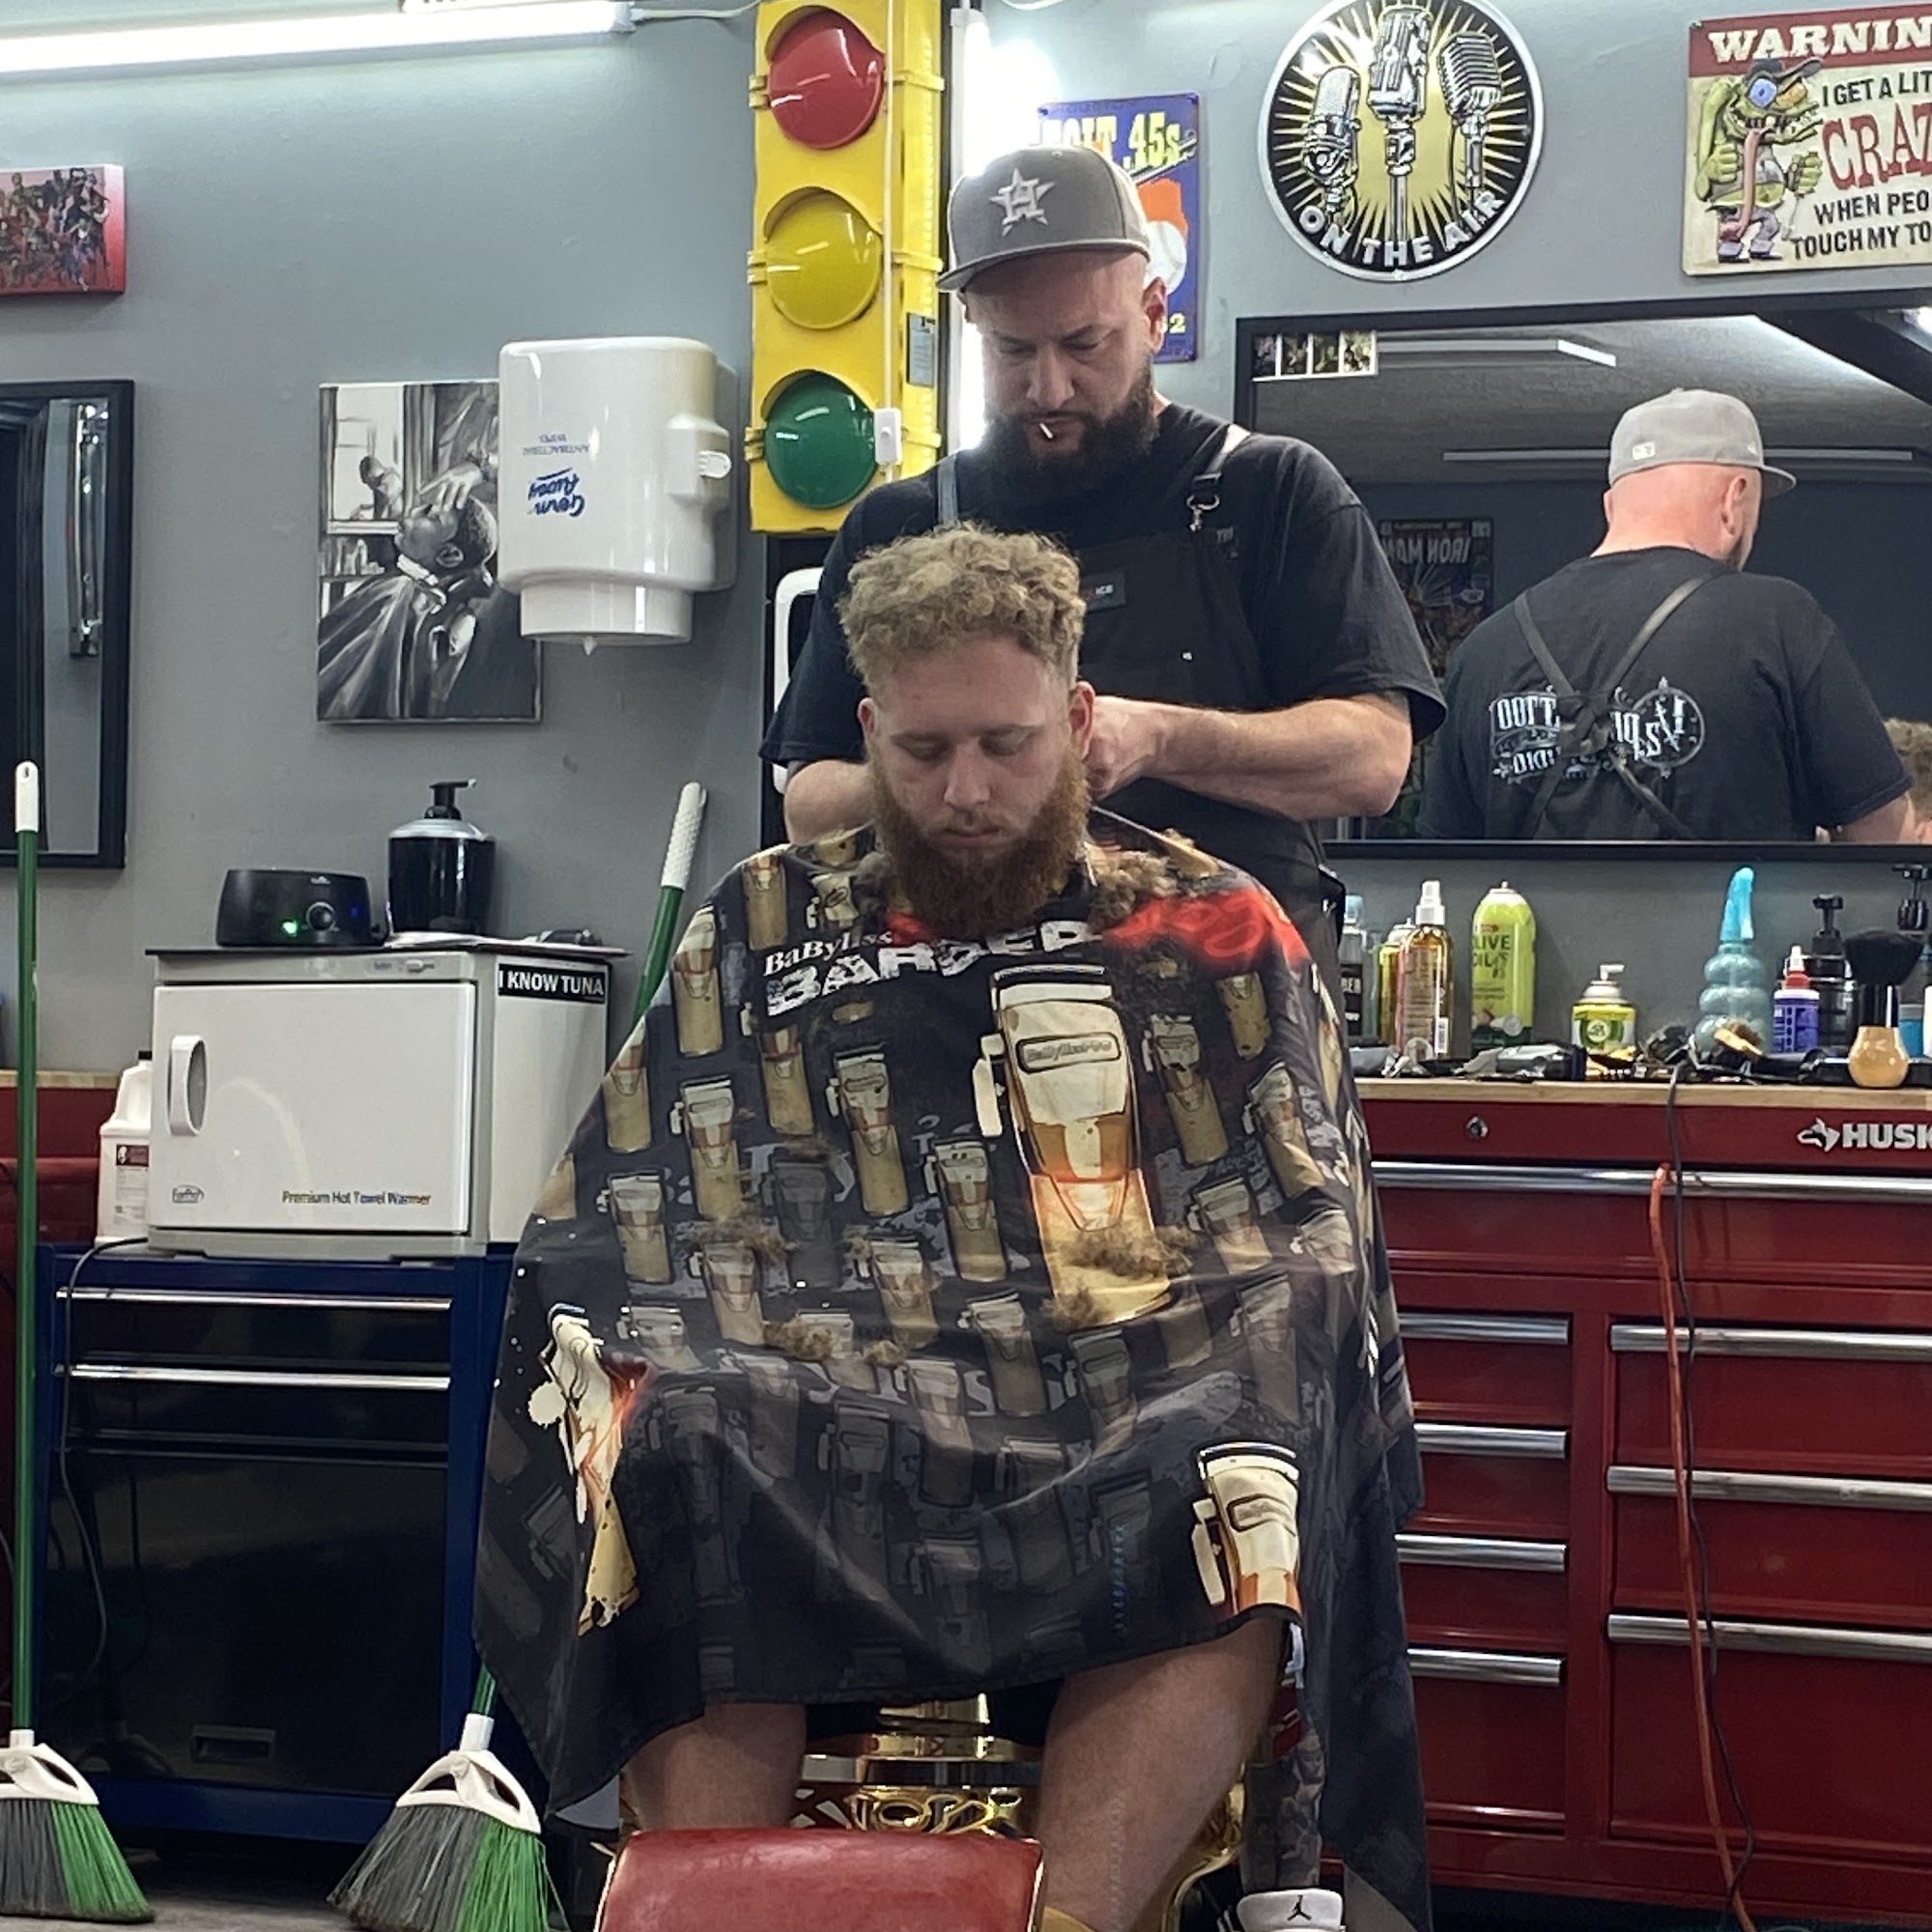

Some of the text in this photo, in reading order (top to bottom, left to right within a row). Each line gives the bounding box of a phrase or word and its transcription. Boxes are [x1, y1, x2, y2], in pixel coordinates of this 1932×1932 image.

[1822, 85, 1829, 107] I
[1834, 78, 1875, 105] GET
[1879, 77, 1893, 99] A
[1813, 189, 1931, 226] WHEN PEO
[1298, 190, 1506, 267] ON THE AIR
[1789, 226, 1863, 261] TOUCH
[1866, 224, 1901, 251] MY
[498, 970, 605, 996] I KNOW TUNA
[282, 1189, 432, 1206] Premium Hot Towel Warmer
